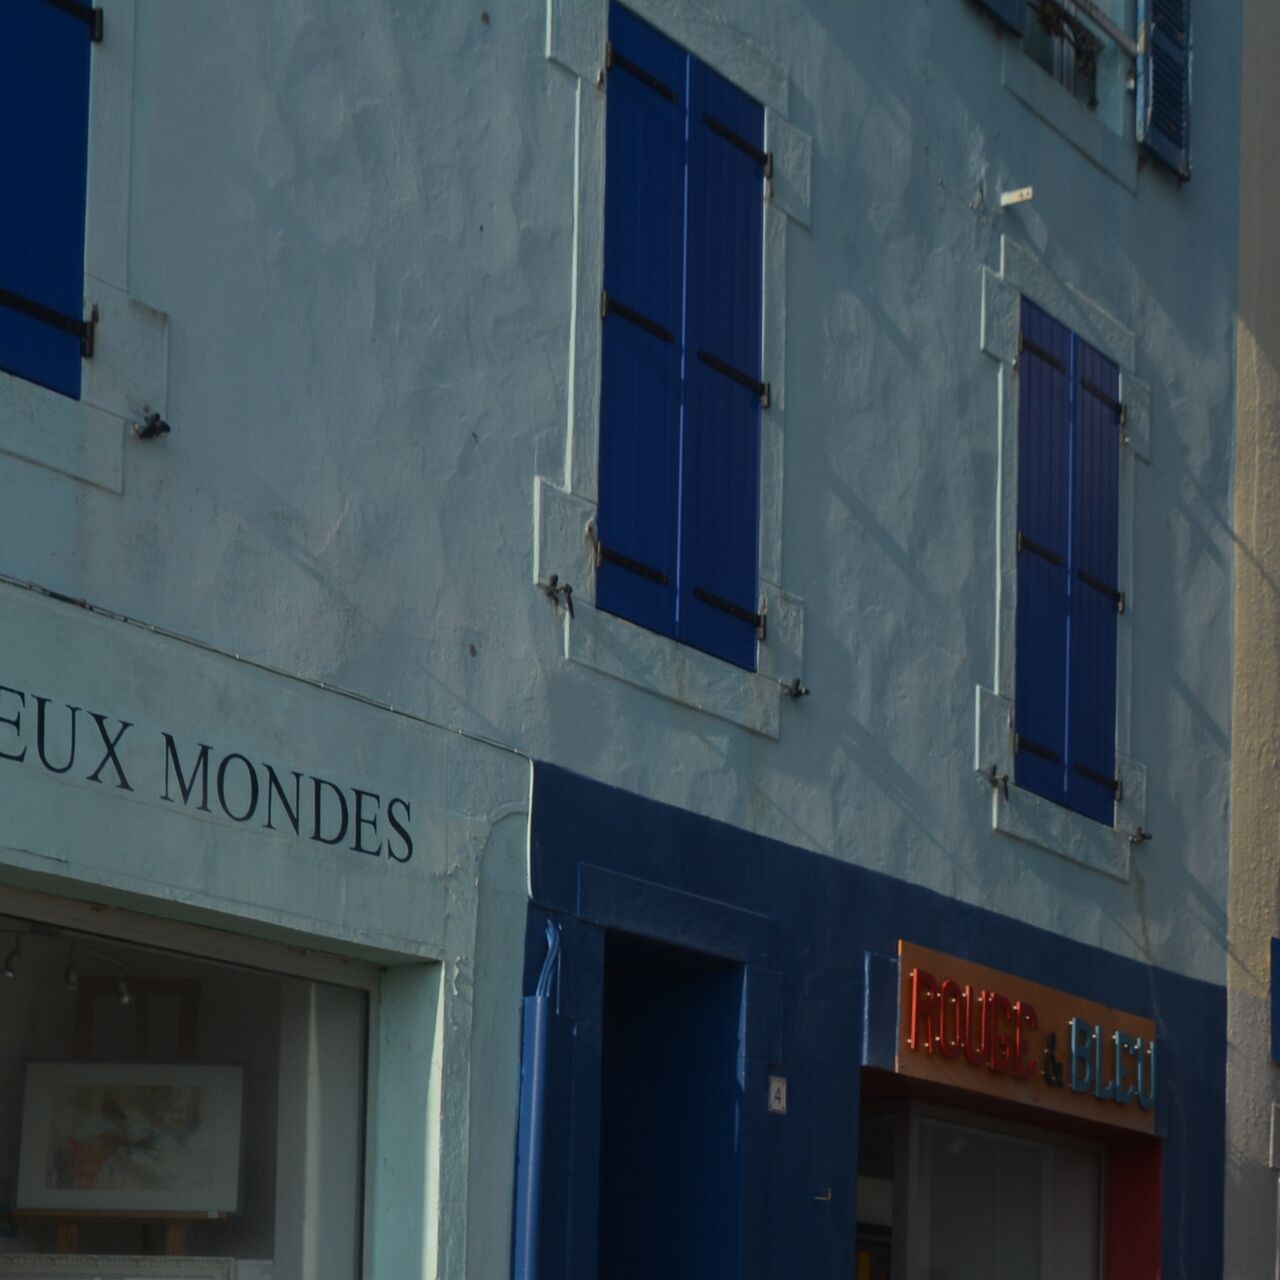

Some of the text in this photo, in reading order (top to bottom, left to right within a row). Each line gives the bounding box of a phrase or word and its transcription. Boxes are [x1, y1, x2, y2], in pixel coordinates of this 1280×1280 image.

[159, 732, 417, 865] MONDES
[906, 967, 1158, 1110] ROUGE & BLEU
